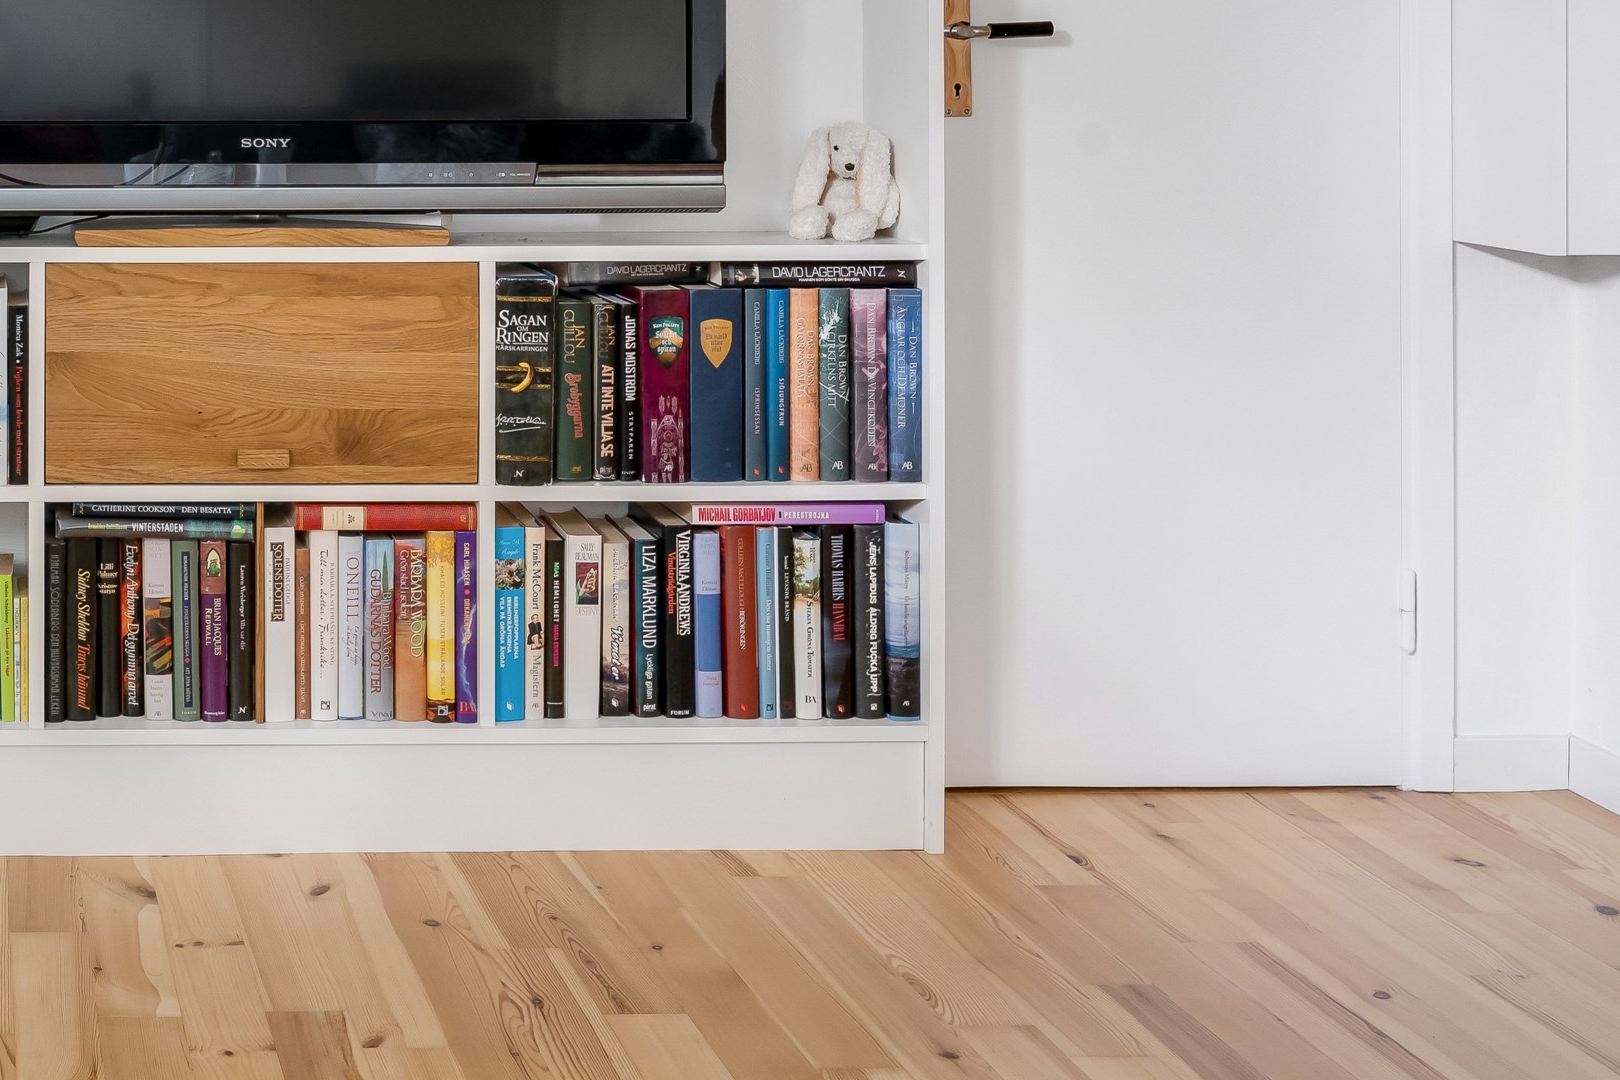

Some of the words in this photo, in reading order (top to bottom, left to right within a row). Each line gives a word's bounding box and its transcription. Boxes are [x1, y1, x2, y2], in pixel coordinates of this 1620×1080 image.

[240, 137, 291, 149] SONY
[772, 265, 803, 278] DAVID
[803, 265, 886, 278] LAGERCRANTZ
[498, 309, 547, 328] SAGAN
[624, 315, 637, 350] JONAS
[495, 327, 549, 345] RINGEN
[563, 309, 576, 363] GUILLOU
[574, 325, 586, 349] JAN
[601, 364, 614, 385] ATT
[624, 351, 637, 402] MOSTRÖM
[564, 373, 584, 439] Brobyggarna
[601, 386, 614, 412] INTE
[601, 411, 614, 443] VILJA
[601, 444, 614, 458] SE
[91, 504, 137, 513] CATHERINE
[138, 505, 176, 514] COOKSON
[180, 506, 198, 515] DEN
[199, 506, 233, 515] BESATTA
[698, 507, 732, 522] MICHAIL
[733, 507, 776, 522] GORBATJOV
[784, 511, 830, 520] PERESTROJKA
[131, 521, 184, 533] VINTERSTADEN
[272, 543, 284, 581] SOLENS
[531, 543, 541, 566] Frank
[642, 544, 657, 572] LIZA
[676, 529, 691, 582] VIRGINIA
[830, 534, 844, 569] THOMAS
[75, 568, 91, 601] Sidney
[346, 556, 359, 622] O'NEILL
[531, 568, 541, 610] McCourt
[667, 551, 677, 614] Vindsträdgården
[831, 570, 845, 601] HARRIS
[869, 572, 878, 609] LAPIDUS
[213, 597, 222, 621] BRIAN
[272, 581, 284, 621] DOTTER
[370, 569, 381, 637] GUDARNAS
[642, 575, 657, 649] MARKLUND
[676, 581, 691, 636] ANDREWS
[75, 601, 91, 641] Sheldon
[204, 607, 213, 646] REDWALL
[213, 622, 222, 656] JACQUES
[75, 643, 91, 672] Tracys
[370, 640, 381, 694] DOTTER
[645, 653, 655, 680] Lyckliga
[530, 654, 541, 698] Magistern
[645, 680, 654, 700] gatan
[869, 679, 878, 698] UPP
